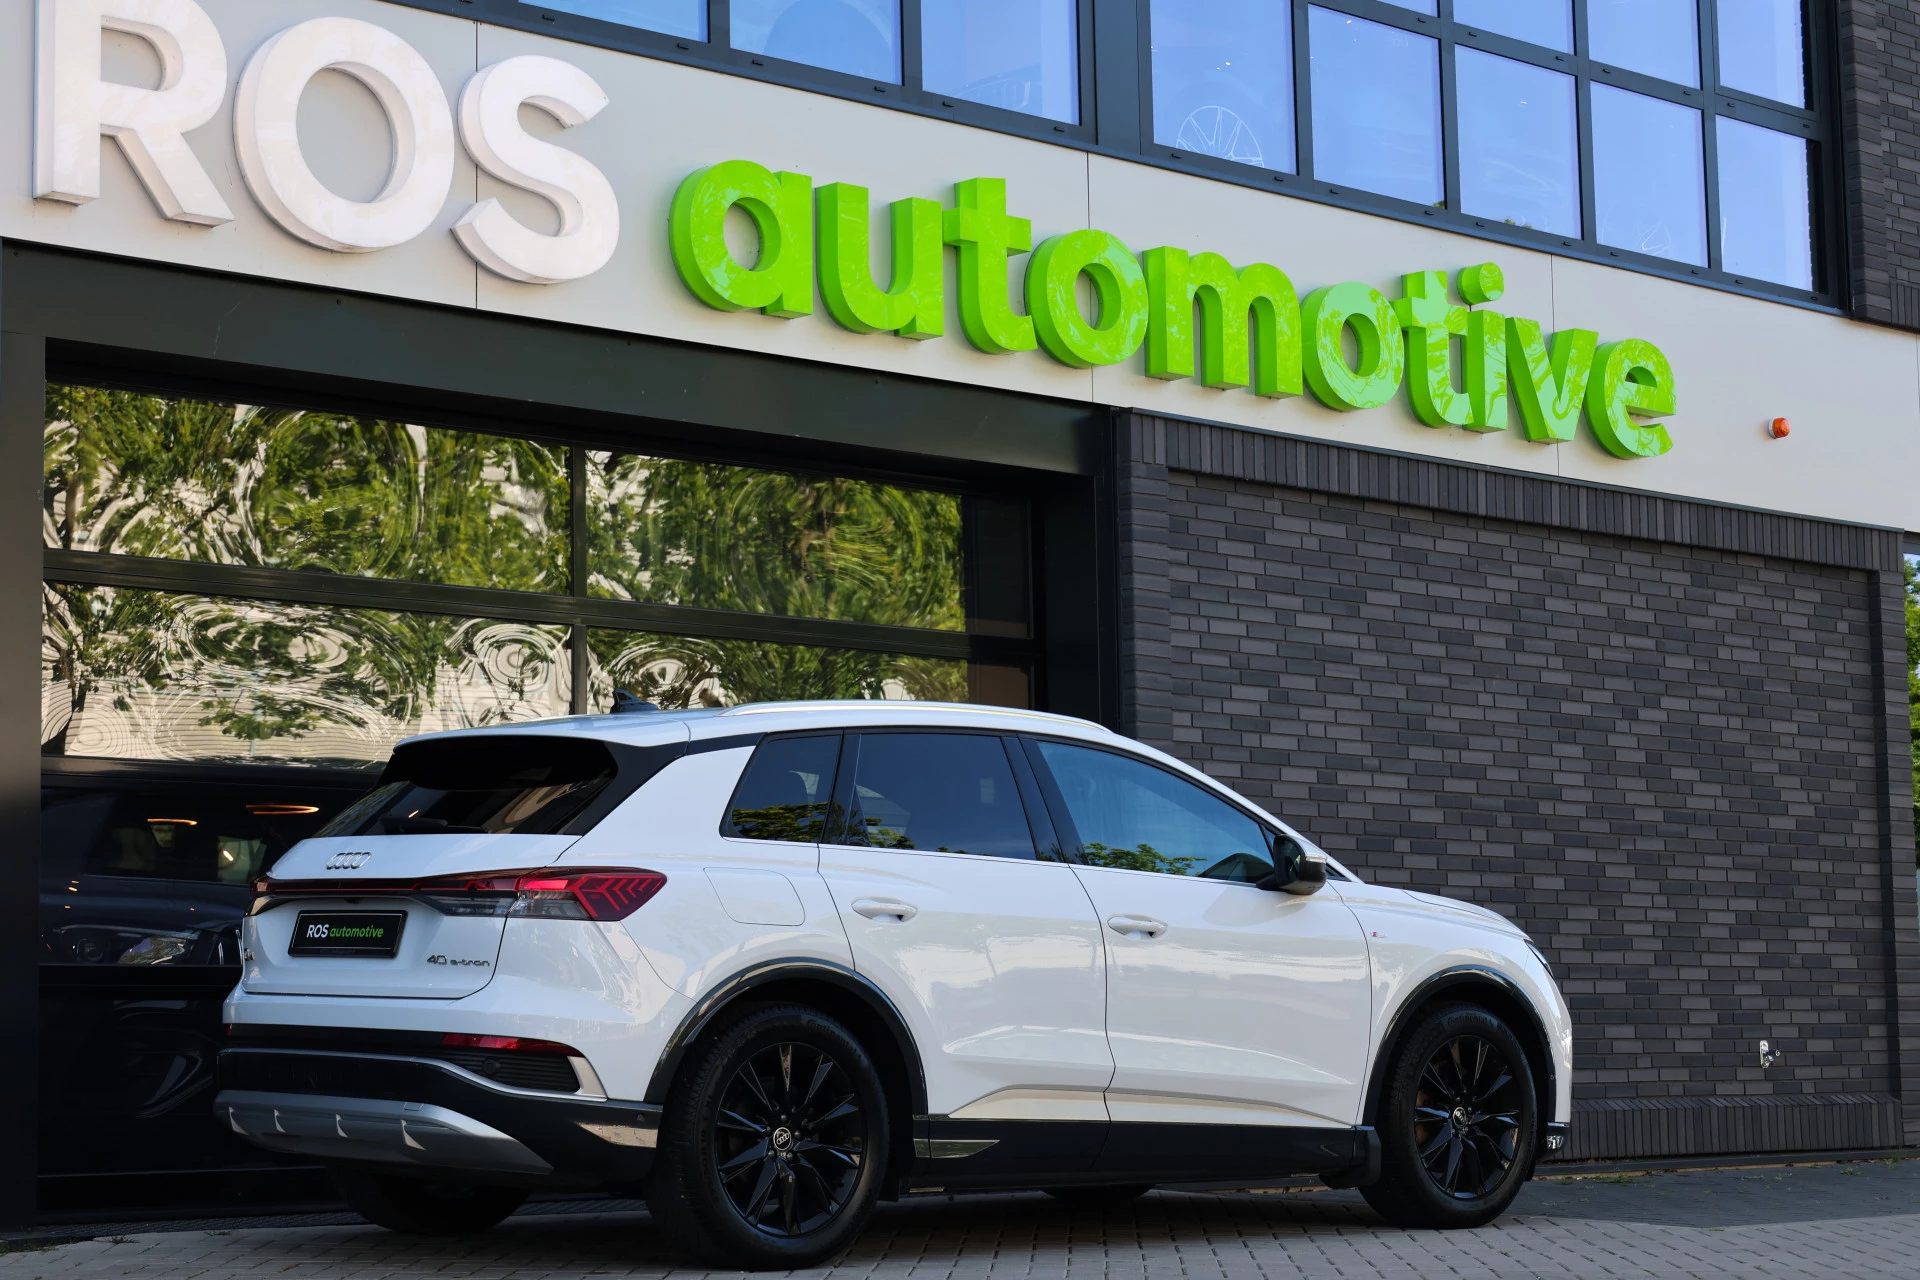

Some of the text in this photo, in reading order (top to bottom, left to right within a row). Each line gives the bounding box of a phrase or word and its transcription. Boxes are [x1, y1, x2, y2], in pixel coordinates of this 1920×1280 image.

[32, 0, 1676, 460] ROS automotive
[307, 924, 384, 938] ROS automotive
[427, 955, 447, 965] 40
